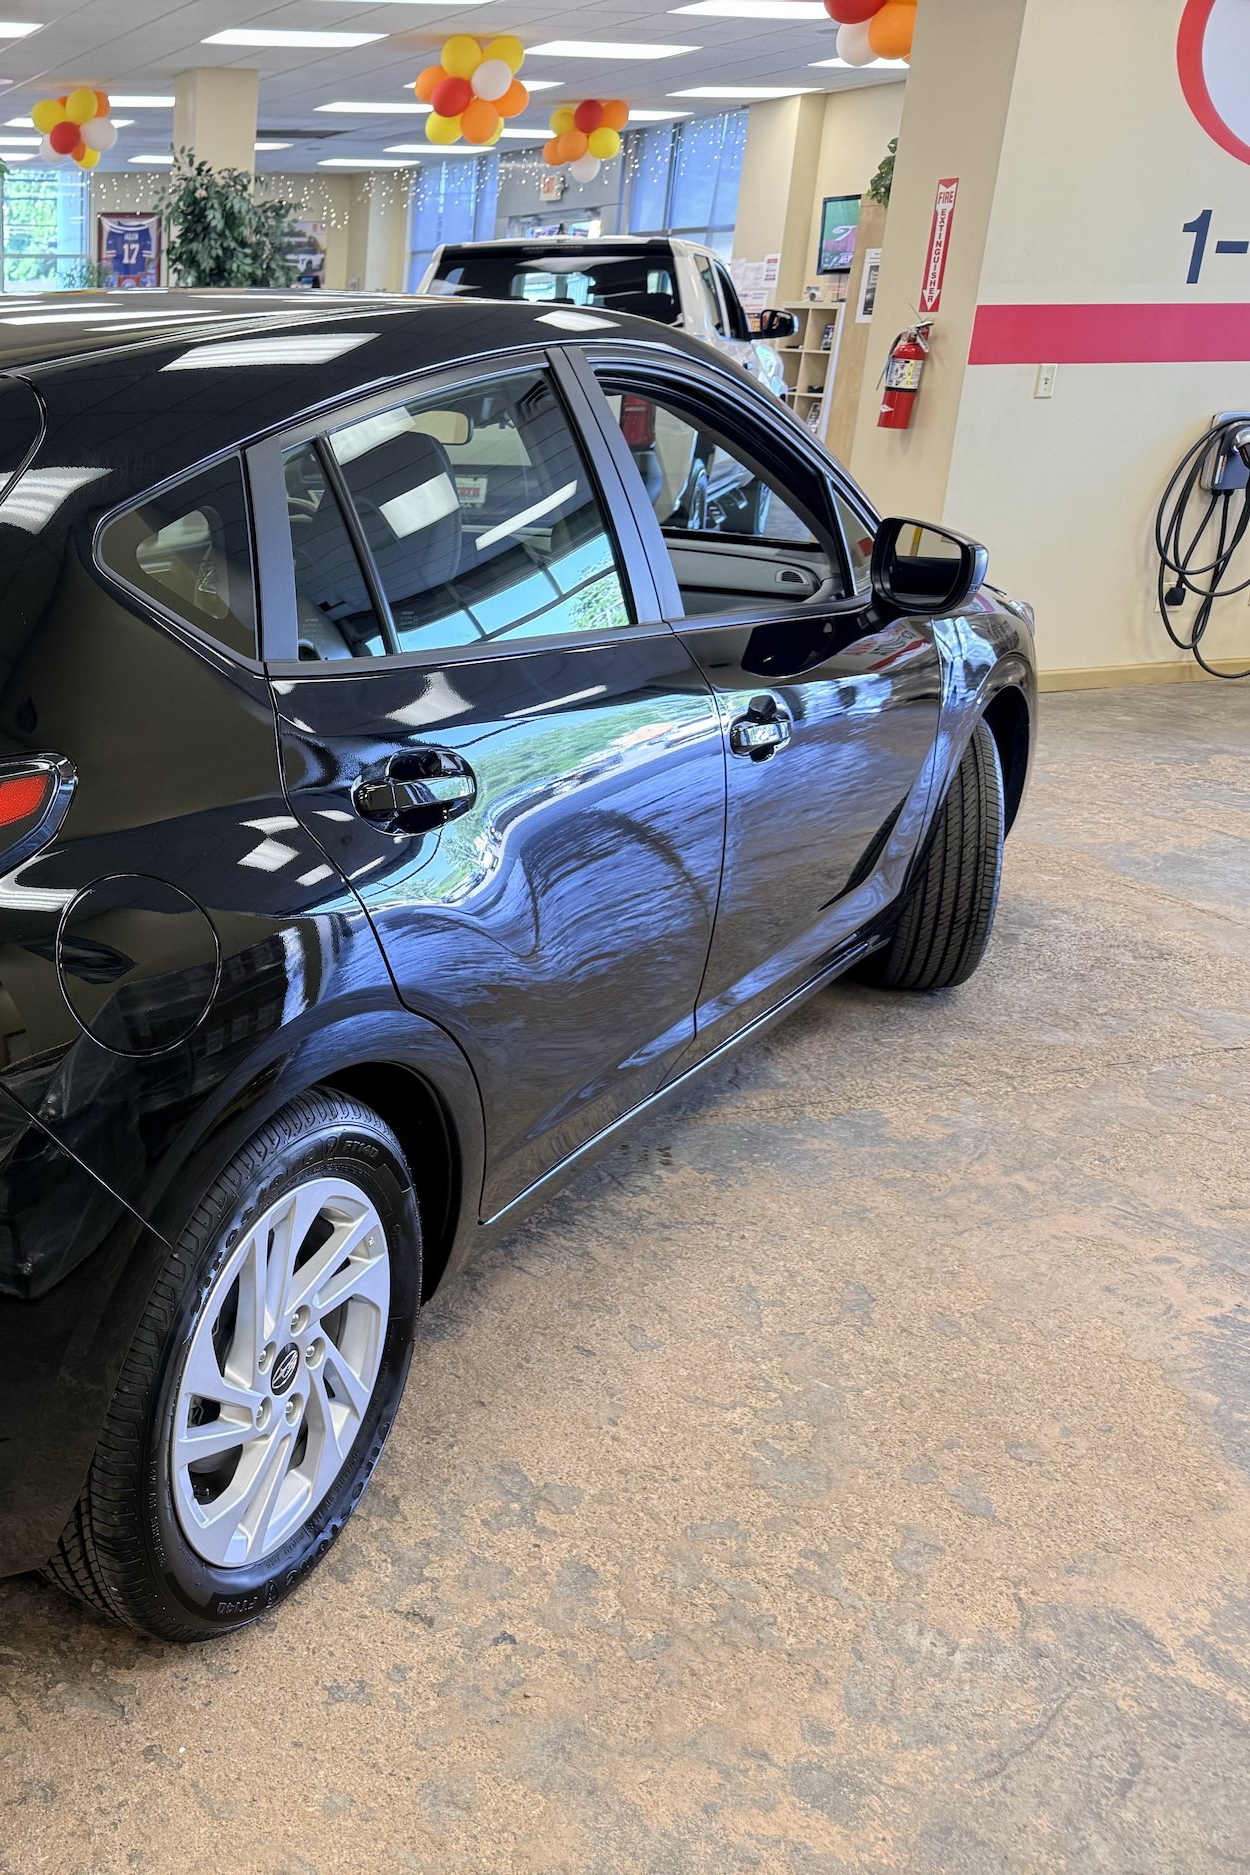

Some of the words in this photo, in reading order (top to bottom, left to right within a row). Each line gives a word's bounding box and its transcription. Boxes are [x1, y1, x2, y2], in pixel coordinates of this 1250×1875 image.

[937, 191, 955, 204] FIRE
[121, 243, 140, 264] 17
[927, 208, 948, 302] EXTINGUISHER
